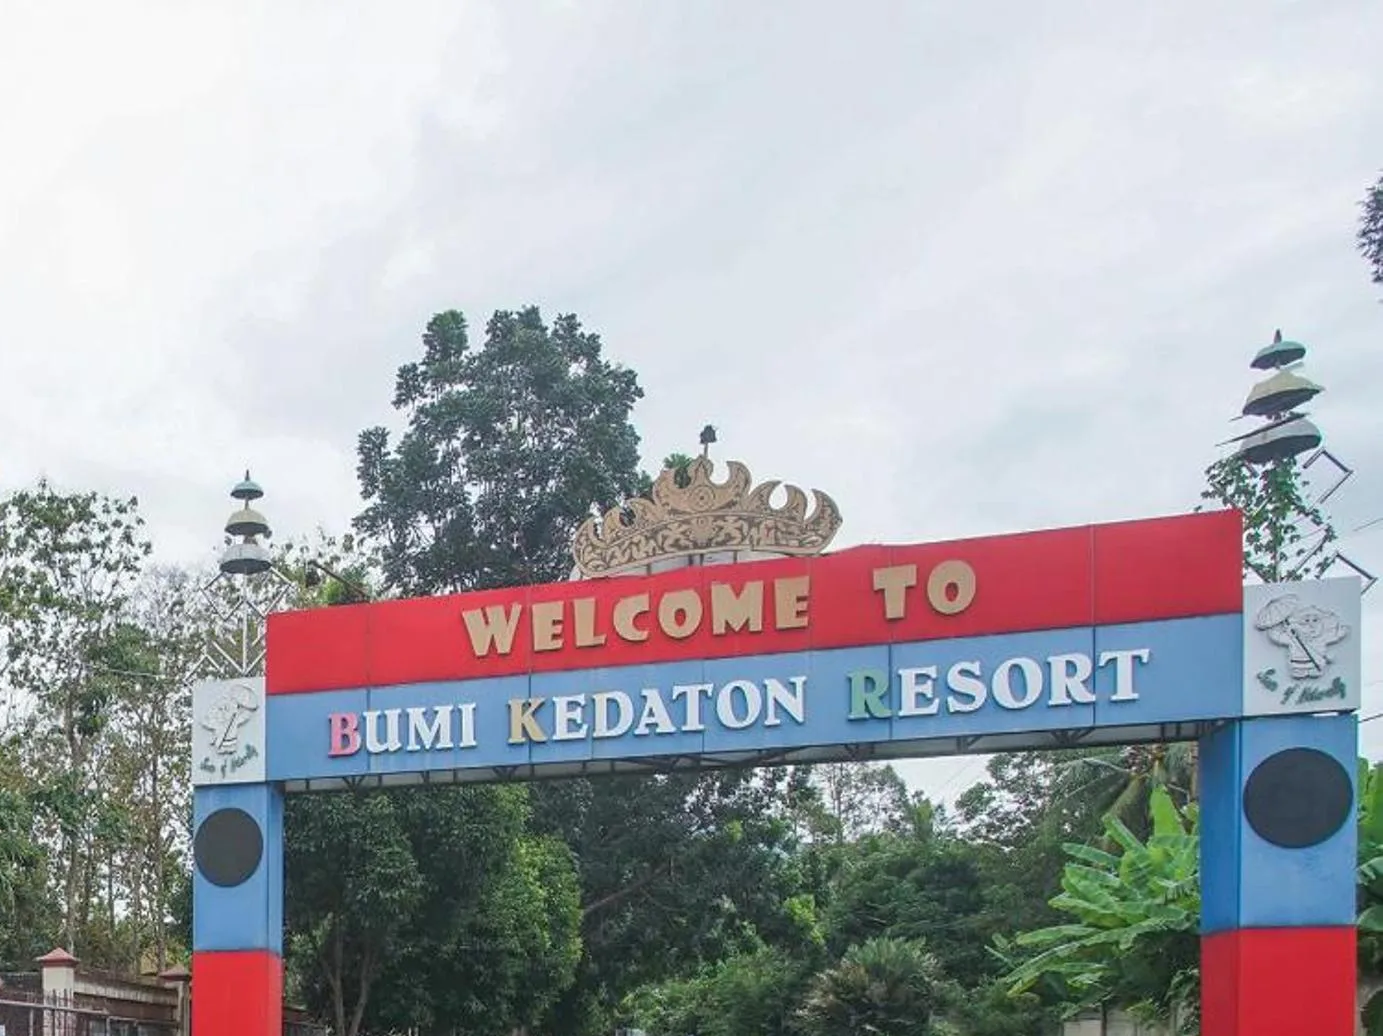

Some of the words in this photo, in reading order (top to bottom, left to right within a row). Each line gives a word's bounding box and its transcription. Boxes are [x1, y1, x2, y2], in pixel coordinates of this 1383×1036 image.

[461, 574, 810, 658] WELCOME
[872, 559, 977, 621] TO
[327, 701, 477, 759] BUMI
[507, 675, 807, 745] KEDATON
[846, 648, 1151, 721] RESORT
